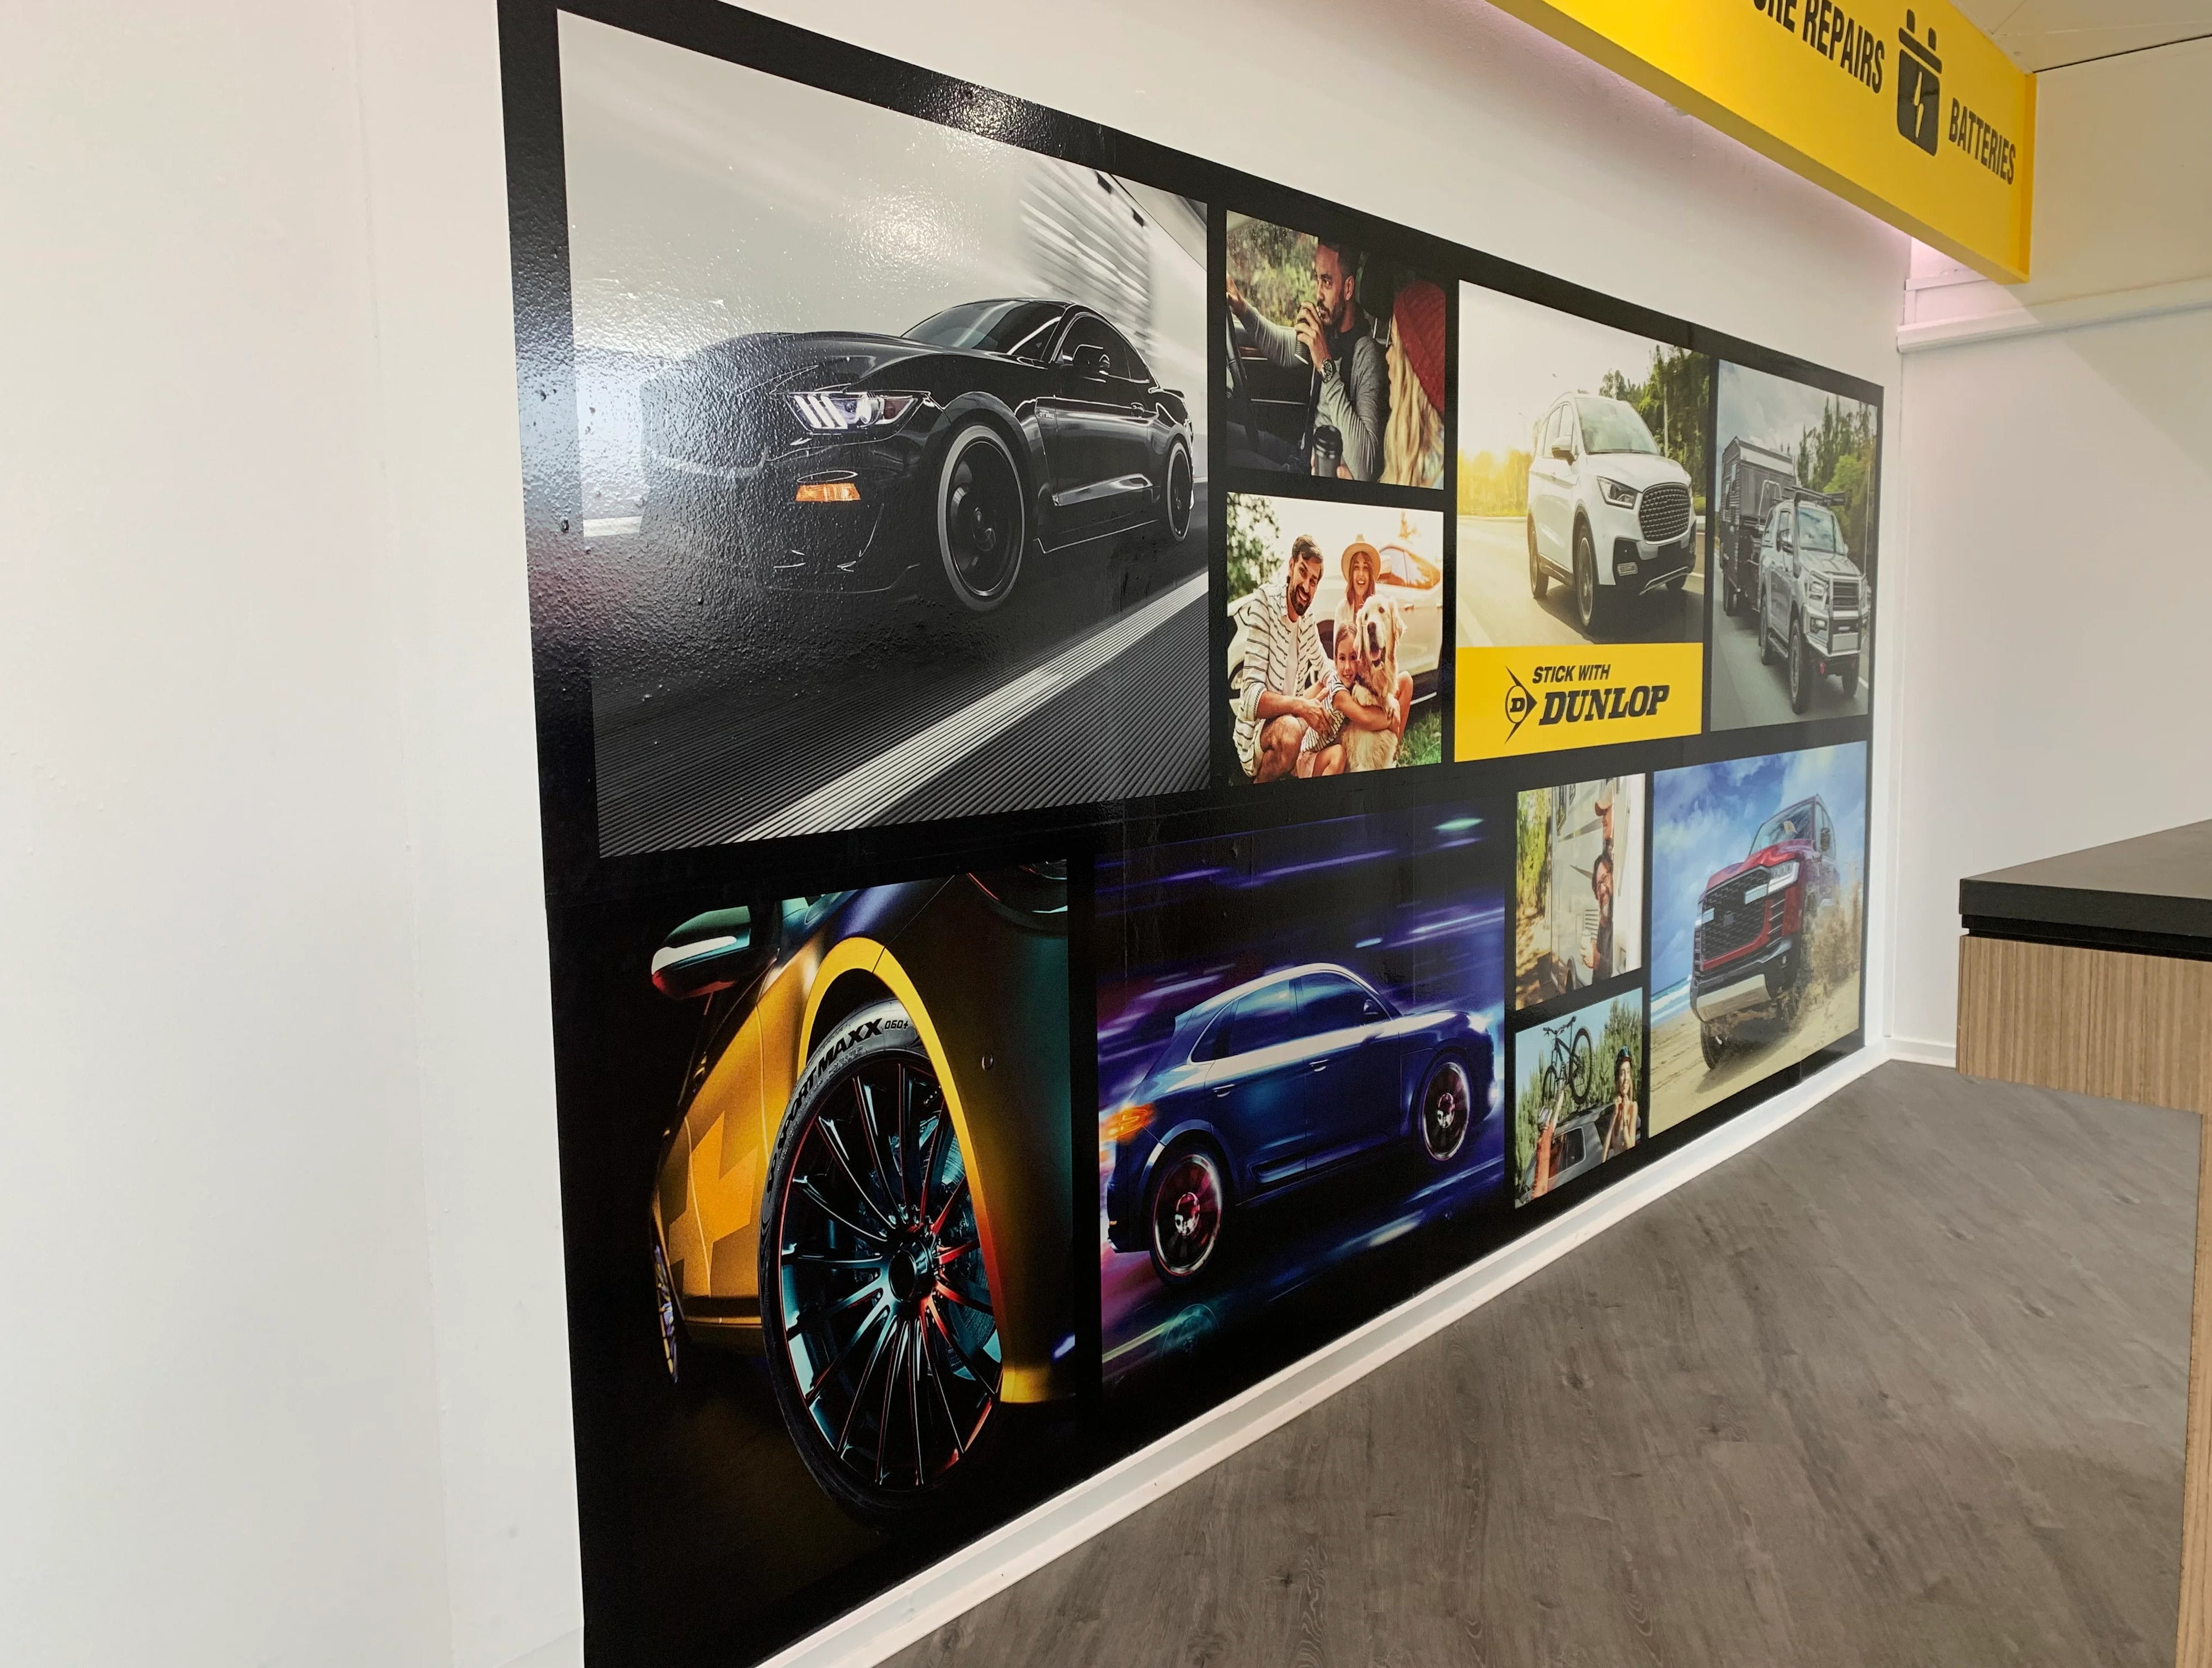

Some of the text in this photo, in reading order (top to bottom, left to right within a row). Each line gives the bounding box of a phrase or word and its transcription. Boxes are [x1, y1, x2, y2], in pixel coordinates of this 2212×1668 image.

[1803, 0, 1885, 93] REPAIRS
[1948, 97, 2016, 185] BATTERIES
[1532, 664, 1611, 684] STICK WITH
[1538, 685, 1670, 726] DUNLOP
[884, 1020, 909, 1030] 060+
